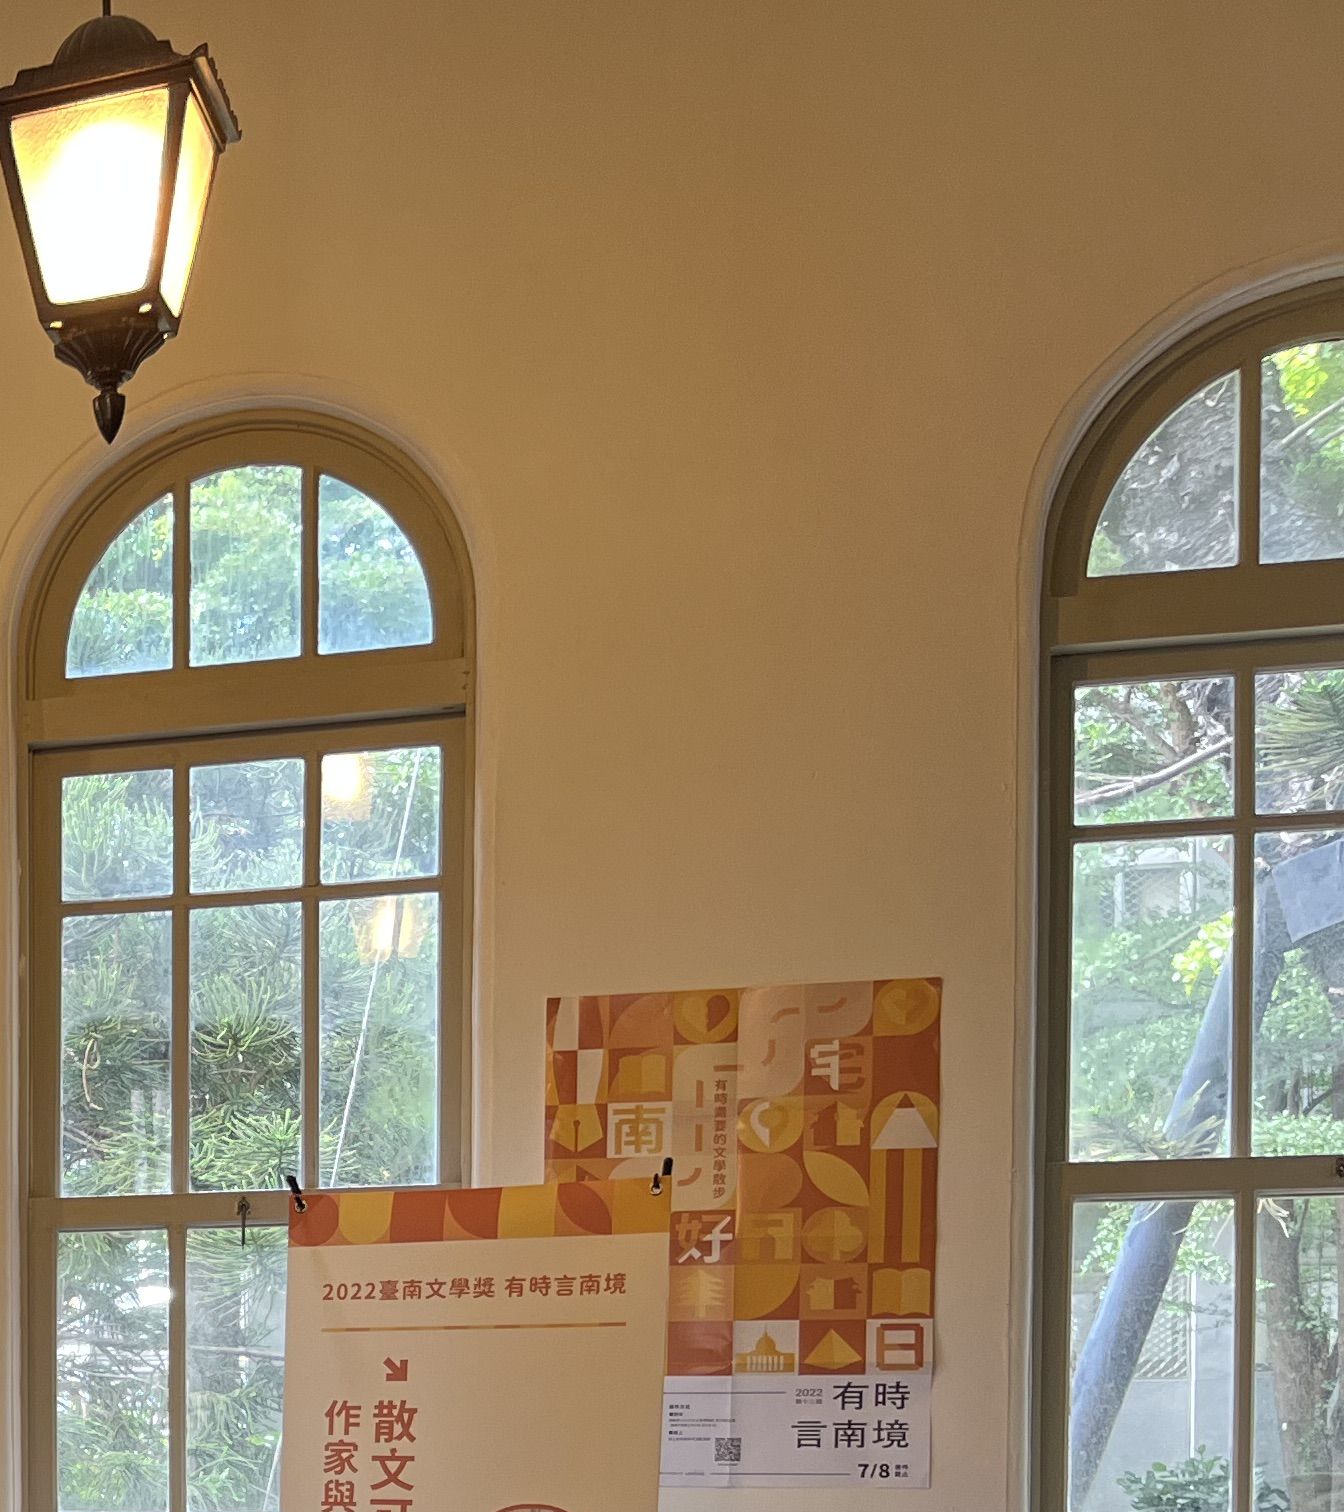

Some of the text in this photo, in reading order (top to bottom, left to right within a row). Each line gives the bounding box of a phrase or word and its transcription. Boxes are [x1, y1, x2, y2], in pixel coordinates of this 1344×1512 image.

[613, 1105, 665, 1155] 南
[675, 1215, 732, 1263] 好
[323, 1273, 626, 1301] 2022臺南文學獎 有時言南境
[796, 1381, 910, 1410] 2022 有時
[792, 1420, 910, 1448] 言南境
[858, 1464, 890, 1478] 7/8
